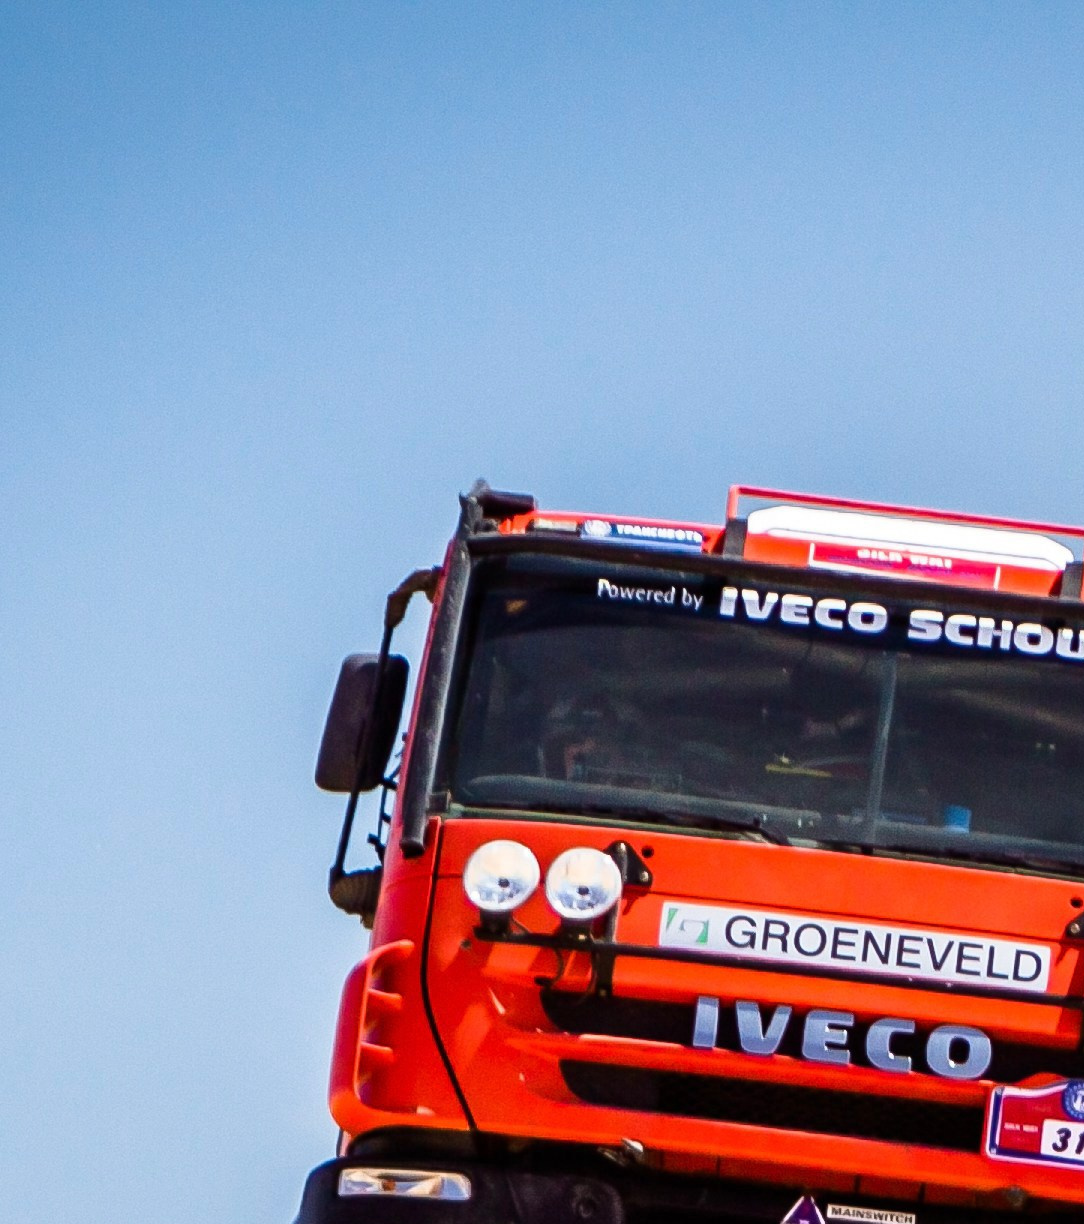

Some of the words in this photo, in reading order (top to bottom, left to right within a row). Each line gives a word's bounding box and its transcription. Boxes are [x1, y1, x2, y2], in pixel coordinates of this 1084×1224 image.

[597, 578, 676, 605] Powered
[681, 586, 704, 612] by
[719, 586, 890, 636] IVECO
[724, 914, 1043, 983] GROENEVELD
[692, 996, 993, 1080] IVECO
[830, 1205, 913, 1224] MAINSWITCH
